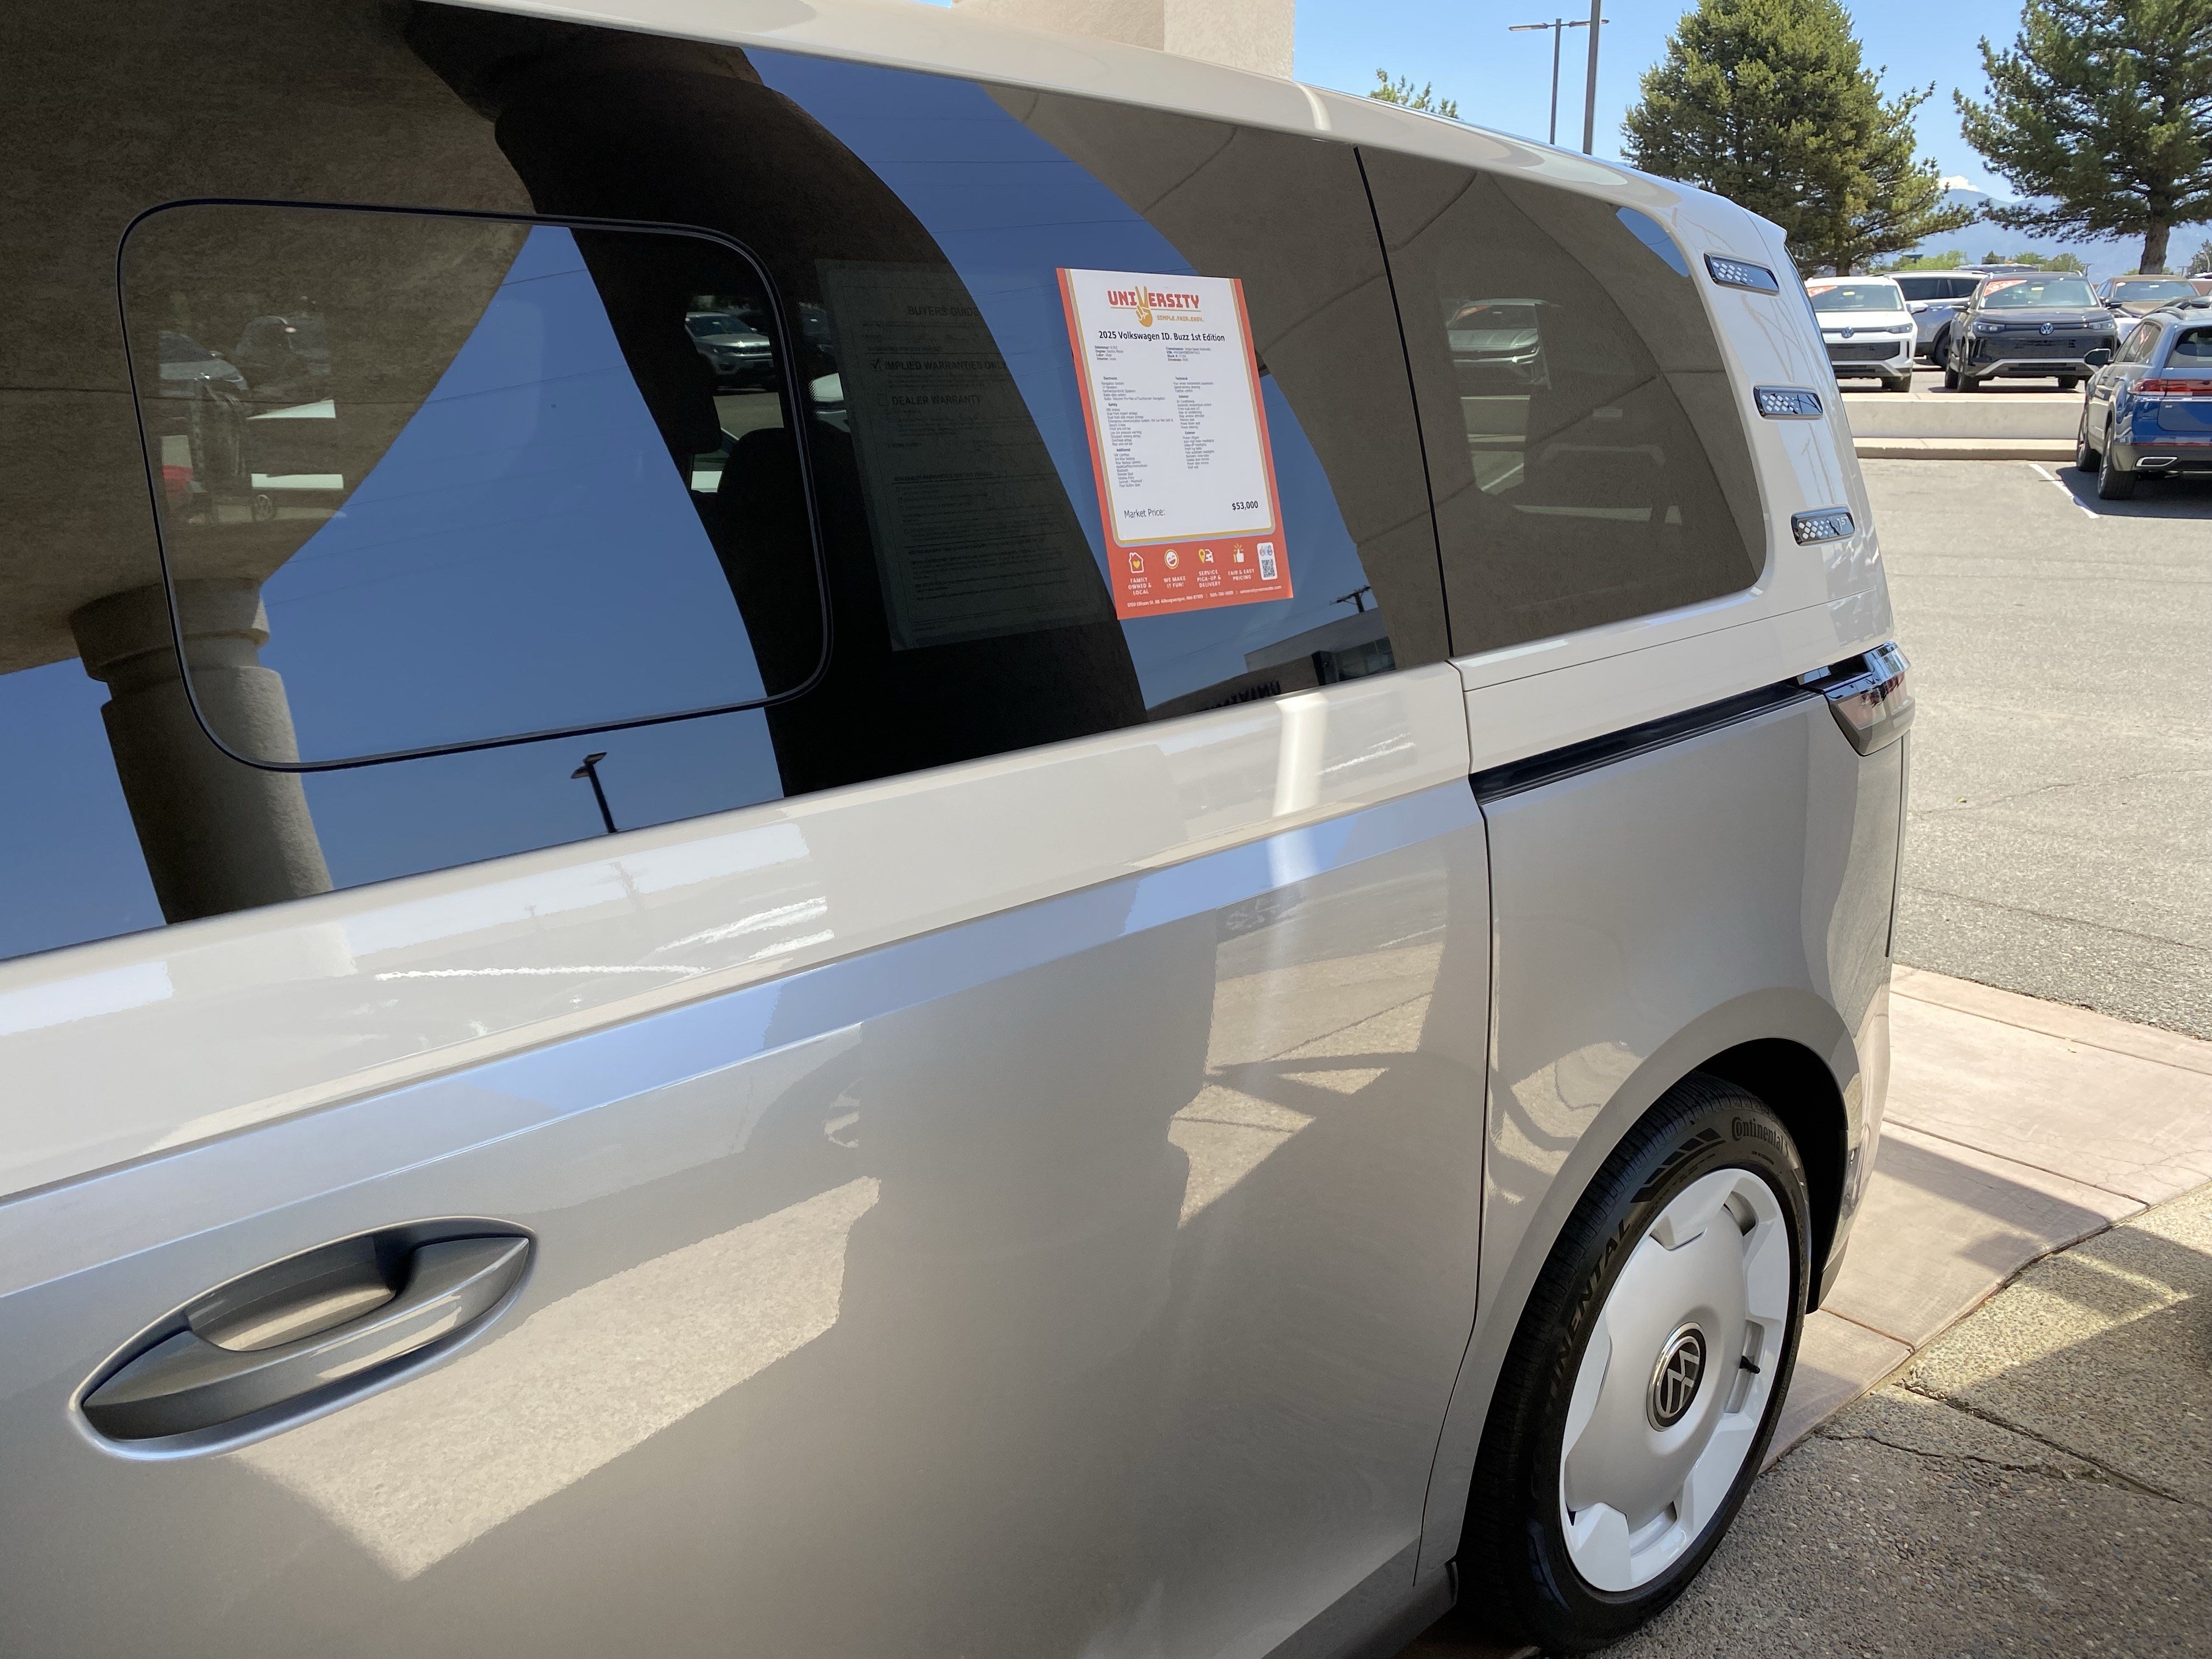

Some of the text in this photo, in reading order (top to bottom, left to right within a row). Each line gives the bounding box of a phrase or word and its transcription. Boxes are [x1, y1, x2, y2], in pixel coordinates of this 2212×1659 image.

[1107, 286, 1200, 309] UNIVERSITY
[907, 306, 947, 316] BUYERS
[1099, 330, 1116, 338] 2025
[1118, 331, 1160, 341] Volkswagen
[1161, 332, 1172, 340] ID.
[1174, 332, 1190, 341] Buzz
[884, 360, 922, 371] IMPLIED
[924, 360, 983, 370] WARRANTIES
[891, 394, 981, 405] DEALER WARRANTY
[1232, 500, 1259, 511] $53,000
[1124, 508, 1165, 518] Market Price:
[1731, 1117, 1783, 1154] Continental
